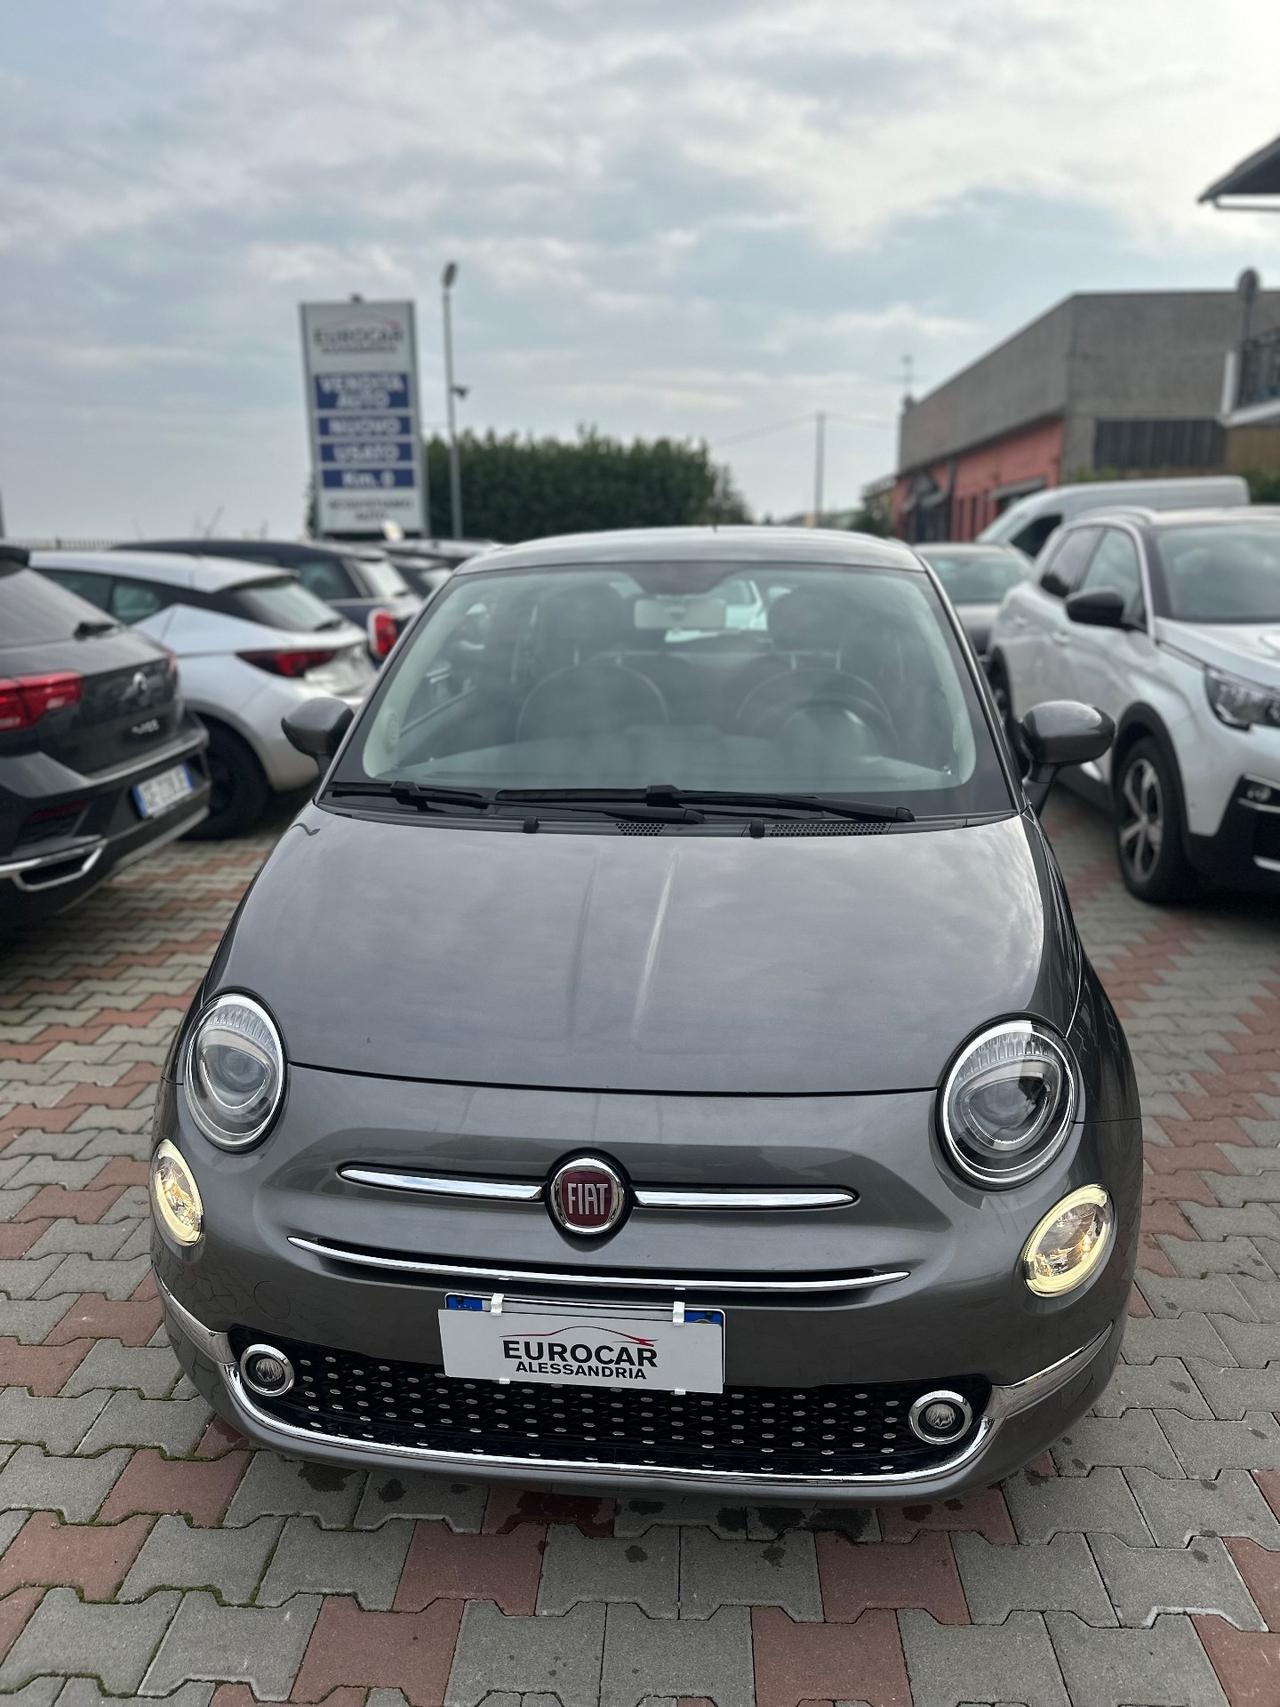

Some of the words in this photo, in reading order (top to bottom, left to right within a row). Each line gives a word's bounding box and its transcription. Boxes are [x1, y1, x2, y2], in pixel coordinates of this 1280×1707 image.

[567, 1183, 608, 1215] FIAT
[502, 1339, 658, 1368] EUROCAR
[515, 1361, 648, 1380] ALESSANDRIA
